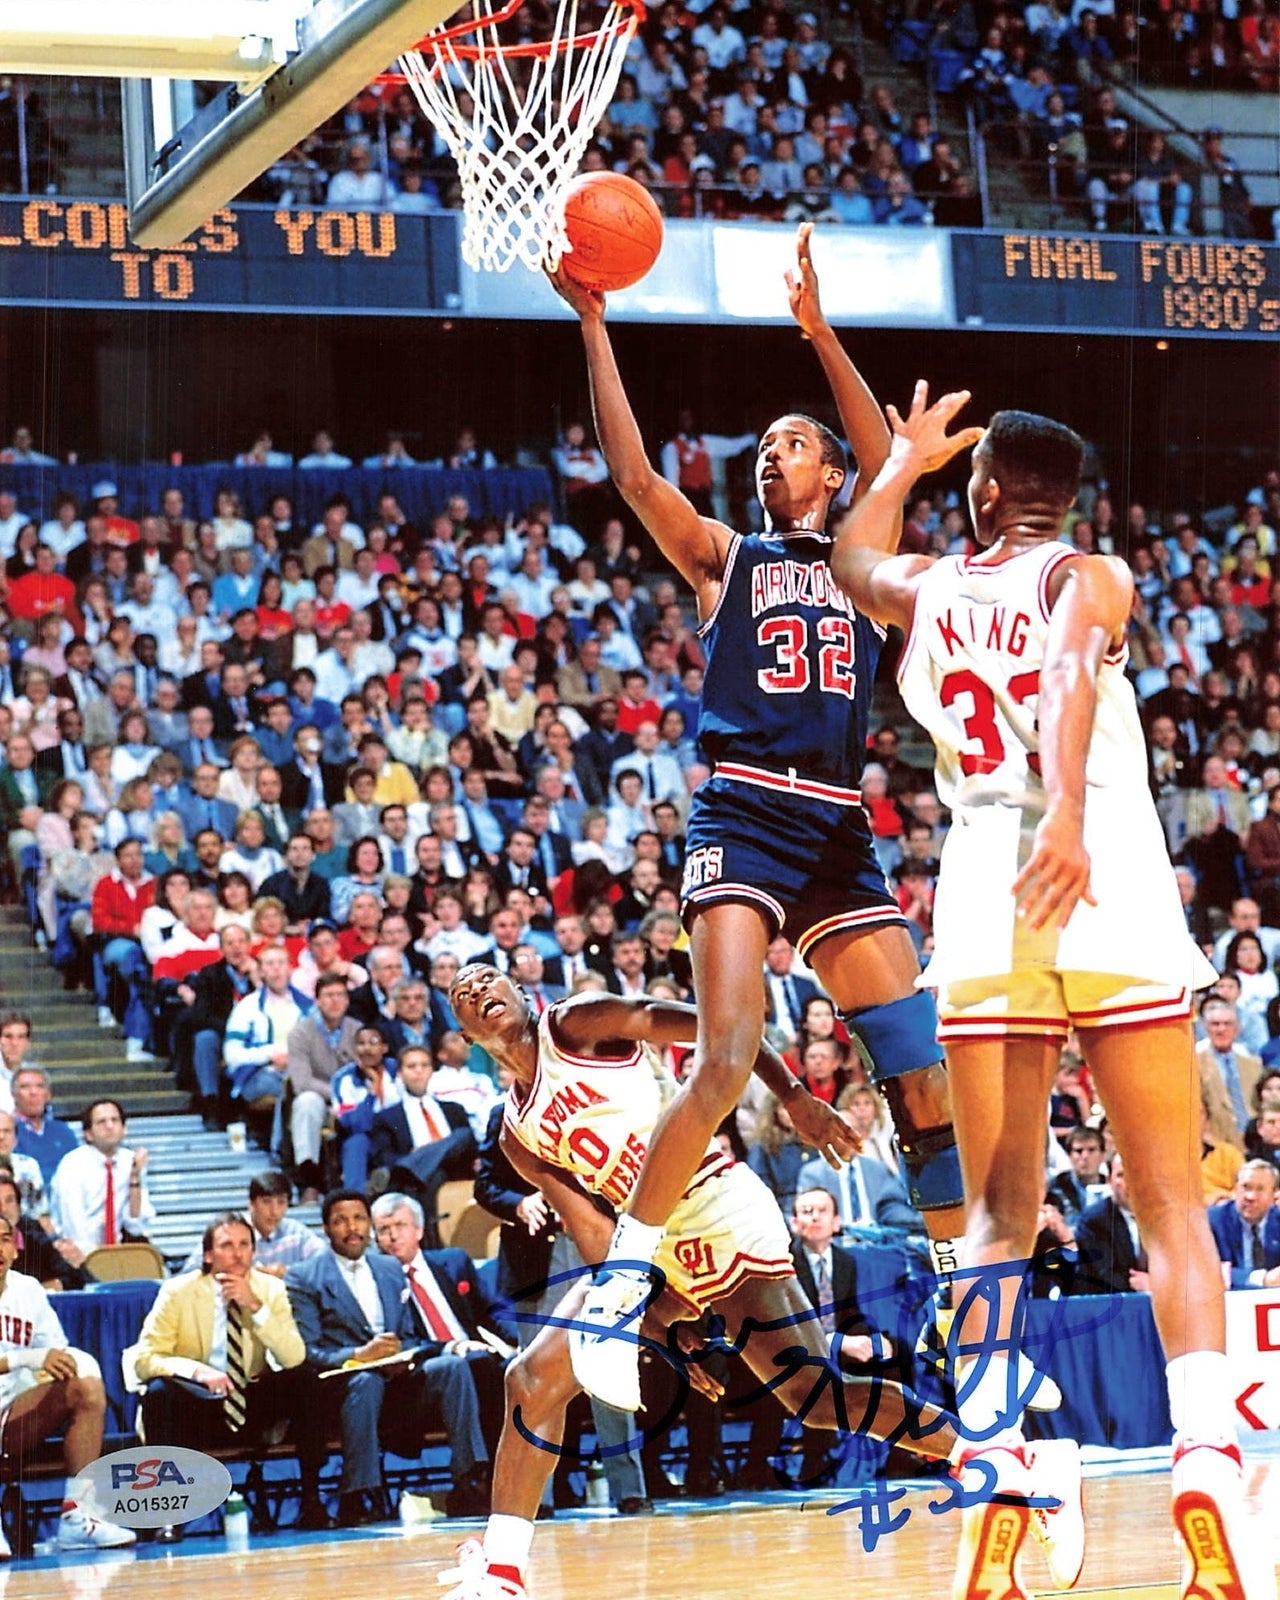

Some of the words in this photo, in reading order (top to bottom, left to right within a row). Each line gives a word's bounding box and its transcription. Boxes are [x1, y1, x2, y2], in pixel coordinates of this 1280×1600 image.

[274, 209, 396, 257] YOU
[110, 252, 194, 299] TO
[1004, 234, 1118, 281] FINAL
[1141, 240, 1266, 286] FOURS
[936, 607, 1031, 657] KING
[757, 615, 856, 700] 32
